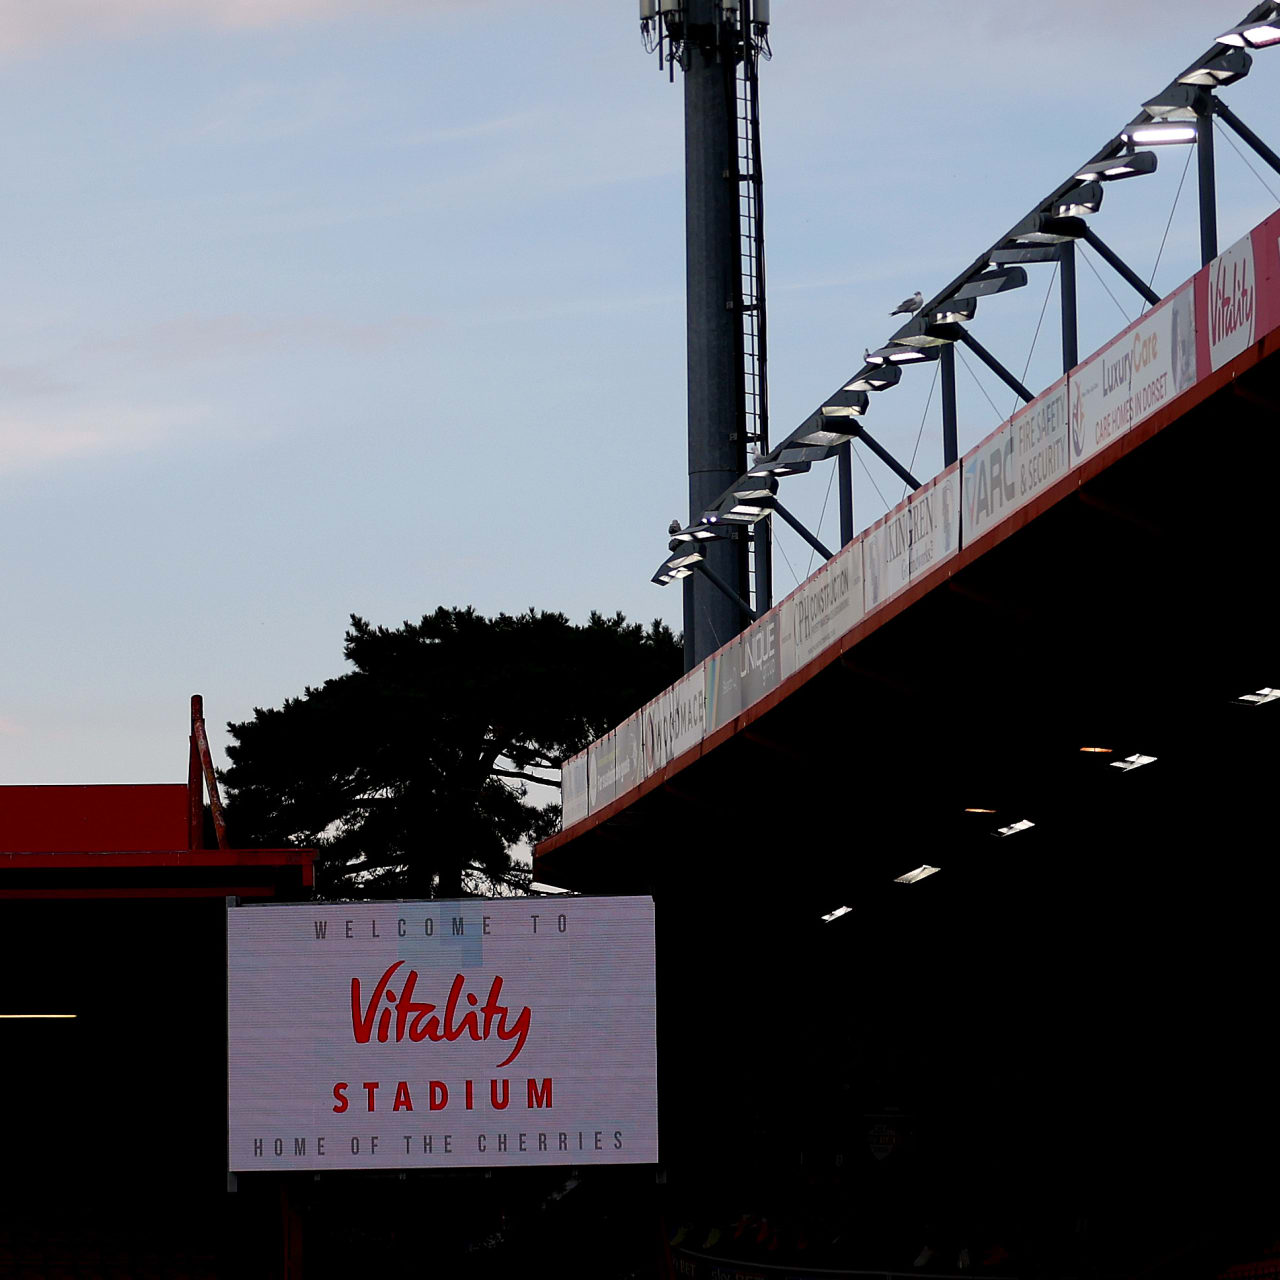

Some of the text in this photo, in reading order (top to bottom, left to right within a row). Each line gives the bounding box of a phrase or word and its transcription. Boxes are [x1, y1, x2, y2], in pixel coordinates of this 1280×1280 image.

[1209, 257, 1254, 348] Vitality
[1019, 393, 1065, 456] FIRE SAFETY
[1096, 372, 1167, 445] CARE HOMES IN DORSET
[1028, 439, 1065, 489] SECURITY
[314, 914, 568, 940] WELCOME TO
[351, 960, 531, 1068] Vitality
[332, 1078, 553, 1114] STADIUM
[254, 1131, 623, 1158] HOME OF THE CHERRIES
